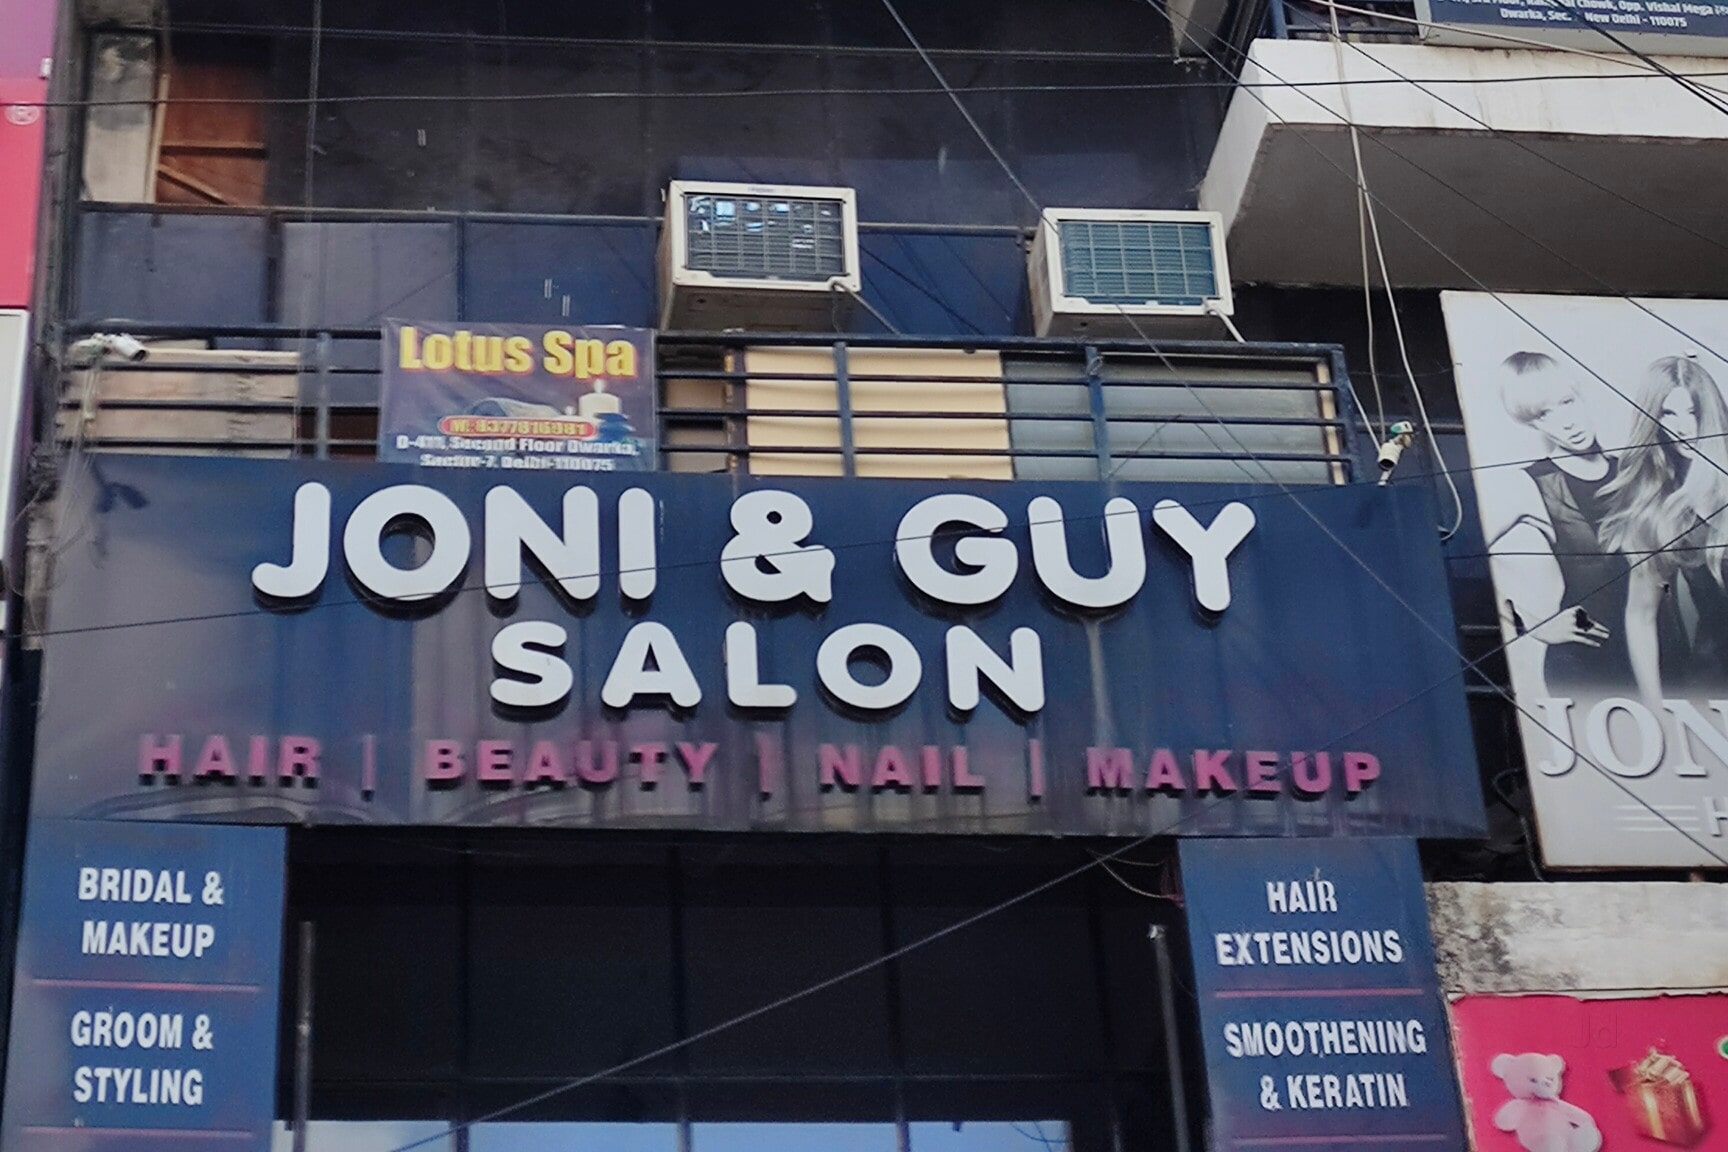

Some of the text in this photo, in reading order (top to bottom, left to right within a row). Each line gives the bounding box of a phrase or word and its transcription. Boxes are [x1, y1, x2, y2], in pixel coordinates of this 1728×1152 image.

[1500, 8, 1547, 22] Dwarka,
[1547, 10, 1573, 22] Sec.
[1584, 12, 1611, 24] New
[1611, 13, 1641, 26] Delhi
[1619, 0, 1645, 13] Opp.
[1646, 1, 1682, 14] Vishal
[1682, 3, 1714, 17] Mega
[399, 326, 638, 379] Lotus Spa
[519, 437, 564, 453] Floor
[252, 481, 1257, 613] JONI & GUY
[489, 620, 1046, 713] SALON
[138, 733, 1383, 795] HAIR BEAUTY NAIL MAKEUP
[78, 866, 225, 906] BRIDAL &
[1265, 879, 1339, 914] HAIR
[81, 920, 215, 958] MAKEUP
[1215, 929, 1404, 967] EXTENSIONS
[70, 1010, 214, 1050] GROOM &
[1222, 1019, 1428, 1058] SMOOTHENING
[73, 1066, 203, 1106] STYLING
[1259, 1072, 1408, 1111] & KERATIN
